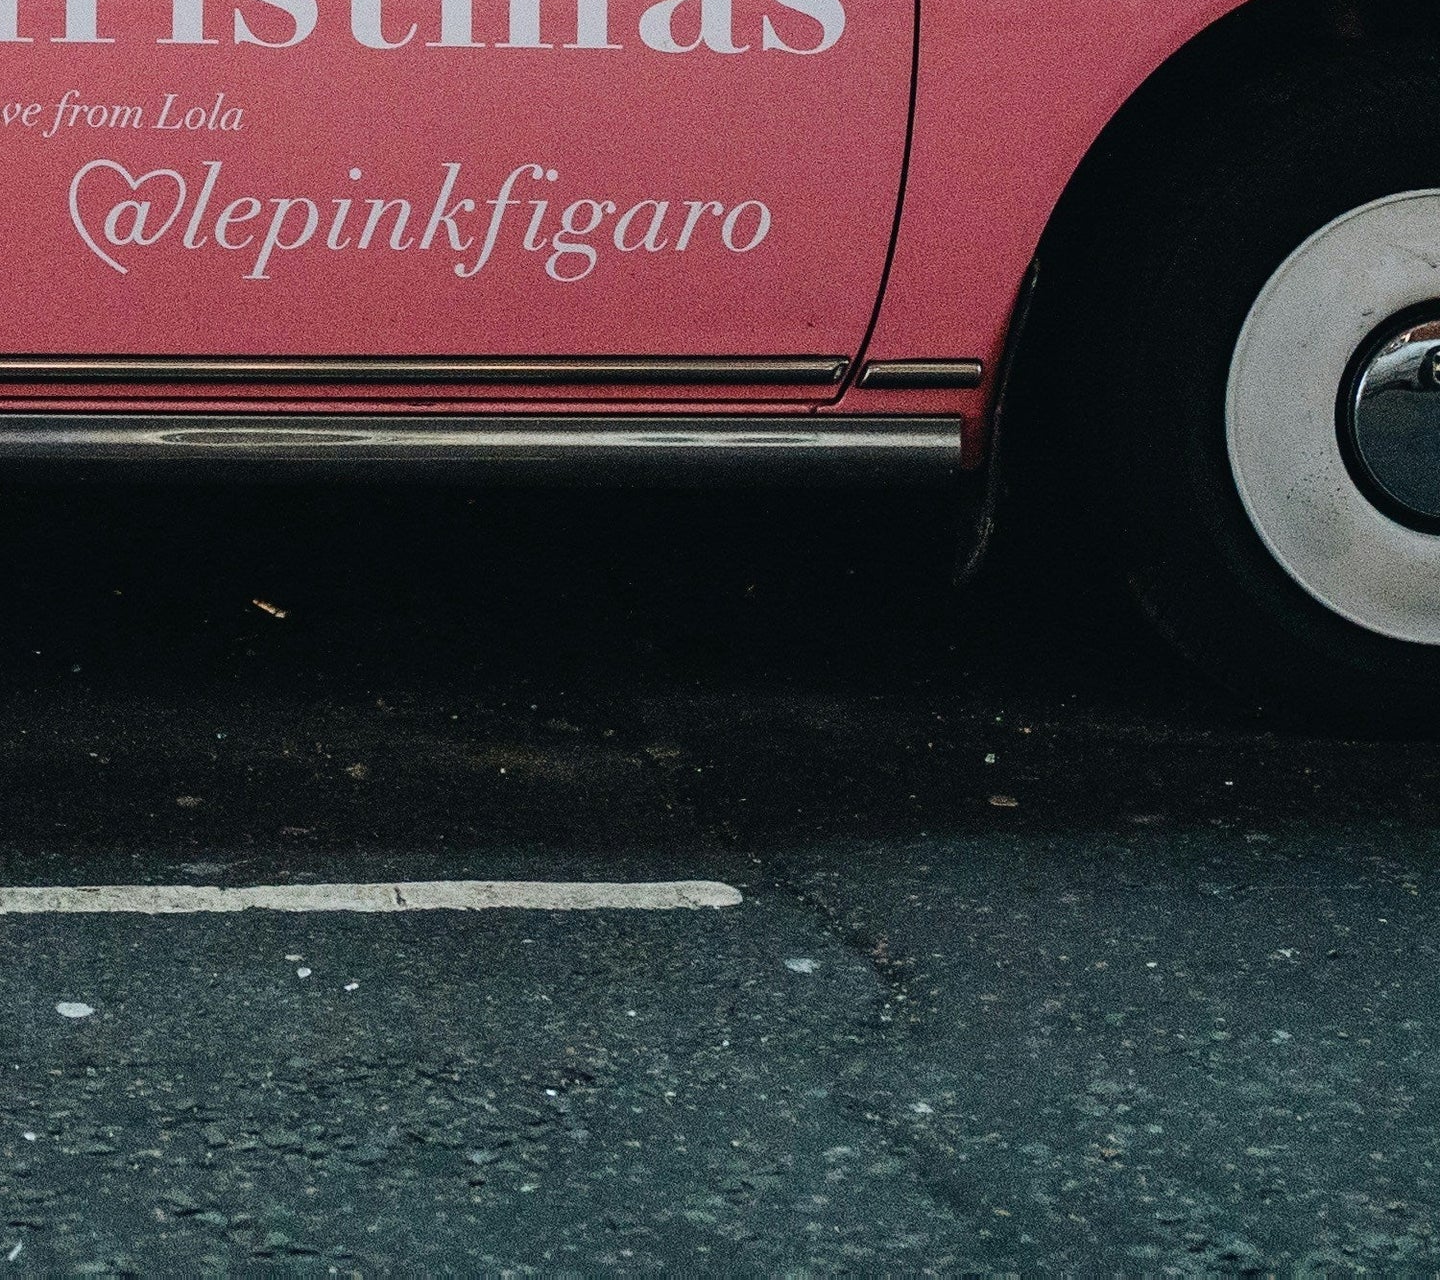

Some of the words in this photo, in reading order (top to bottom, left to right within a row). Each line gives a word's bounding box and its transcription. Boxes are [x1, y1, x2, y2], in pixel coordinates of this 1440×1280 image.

[42, 90, 143, 138] from
[152, 92, 244, 131] Lola
[69, 159, 772, 282] @lepinkfigaro
